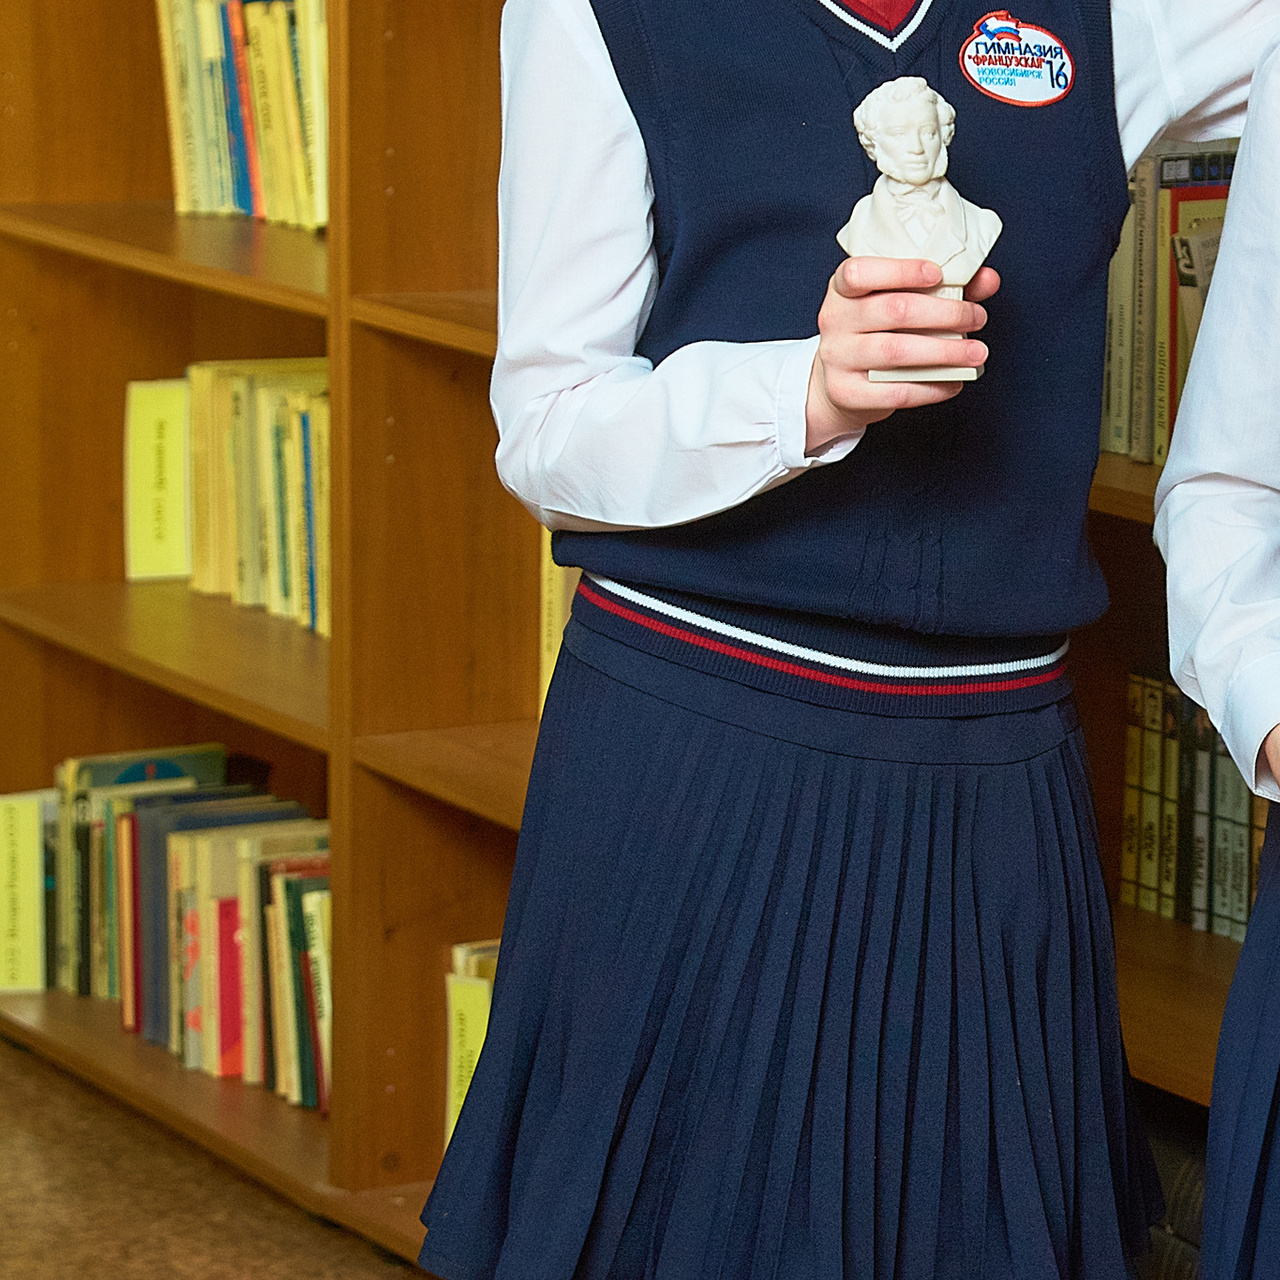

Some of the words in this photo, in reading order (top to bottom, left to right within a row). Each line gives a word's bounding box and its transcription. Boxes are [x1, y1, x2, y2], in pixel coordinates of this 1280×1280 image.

[975, 42, 1063, 59] ГИМНАЗИЯ
[968, 55, 1046, 69] "ФРАНЦУЗСКАЯ"
[977, 68, 1043, 79] НОВОСИБИРСК
[1045, 60, 1068, 89] 16
[979, 77, 1016, 86] РОССИЯ
